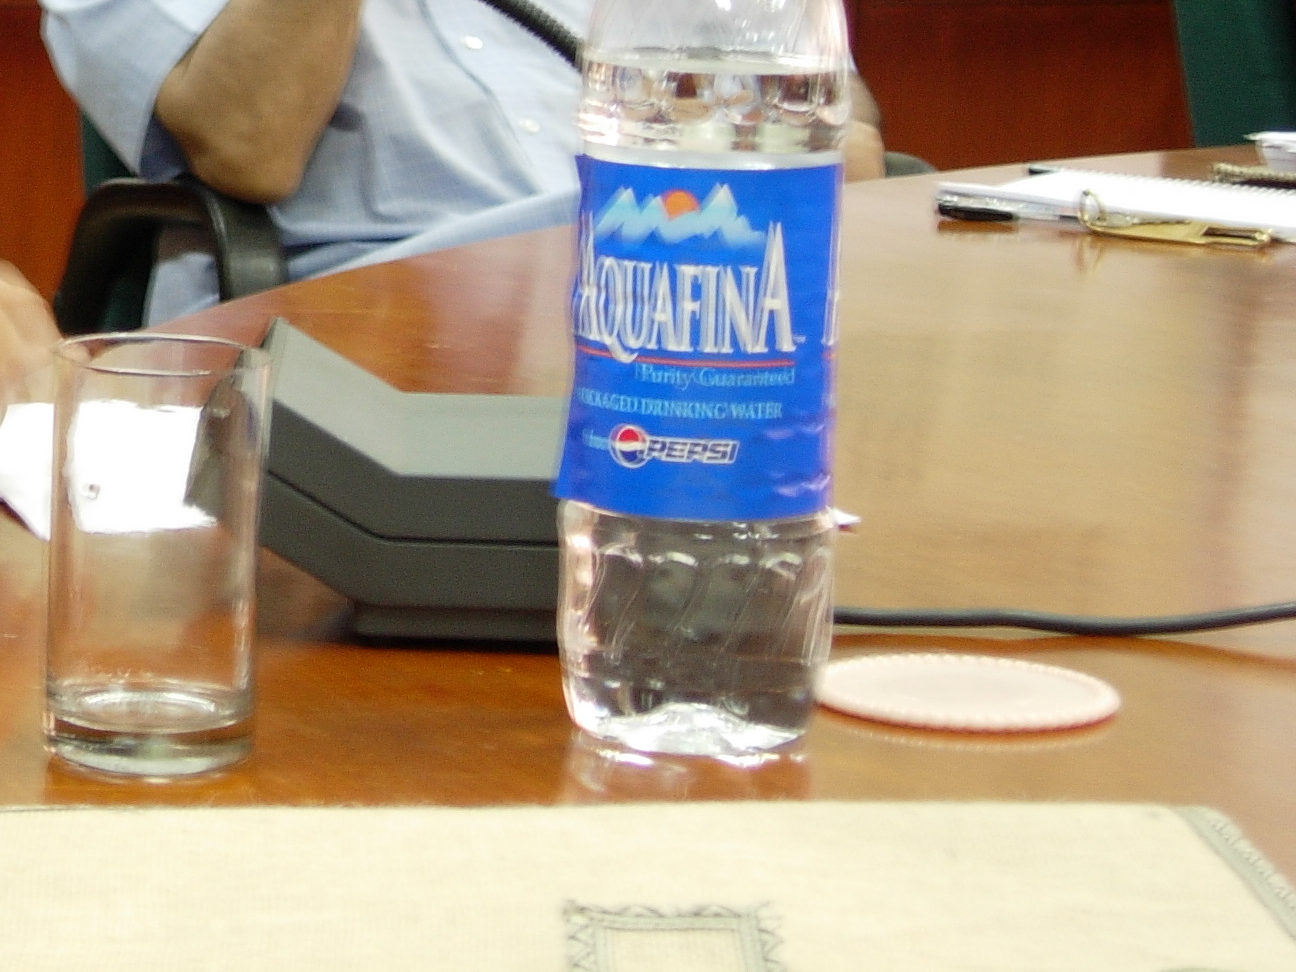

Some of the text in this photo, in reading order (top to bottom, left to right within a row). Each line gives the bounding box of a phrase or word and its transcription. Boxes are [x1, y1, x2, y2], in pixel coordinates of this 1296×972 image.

[573, 209, 798, 363] AQUAFINA
[638, 363, 796, 390] Purity Guaranteed
[730, 400, 783, 420] WATER
[645, 437, 740, 464] PEPSI
